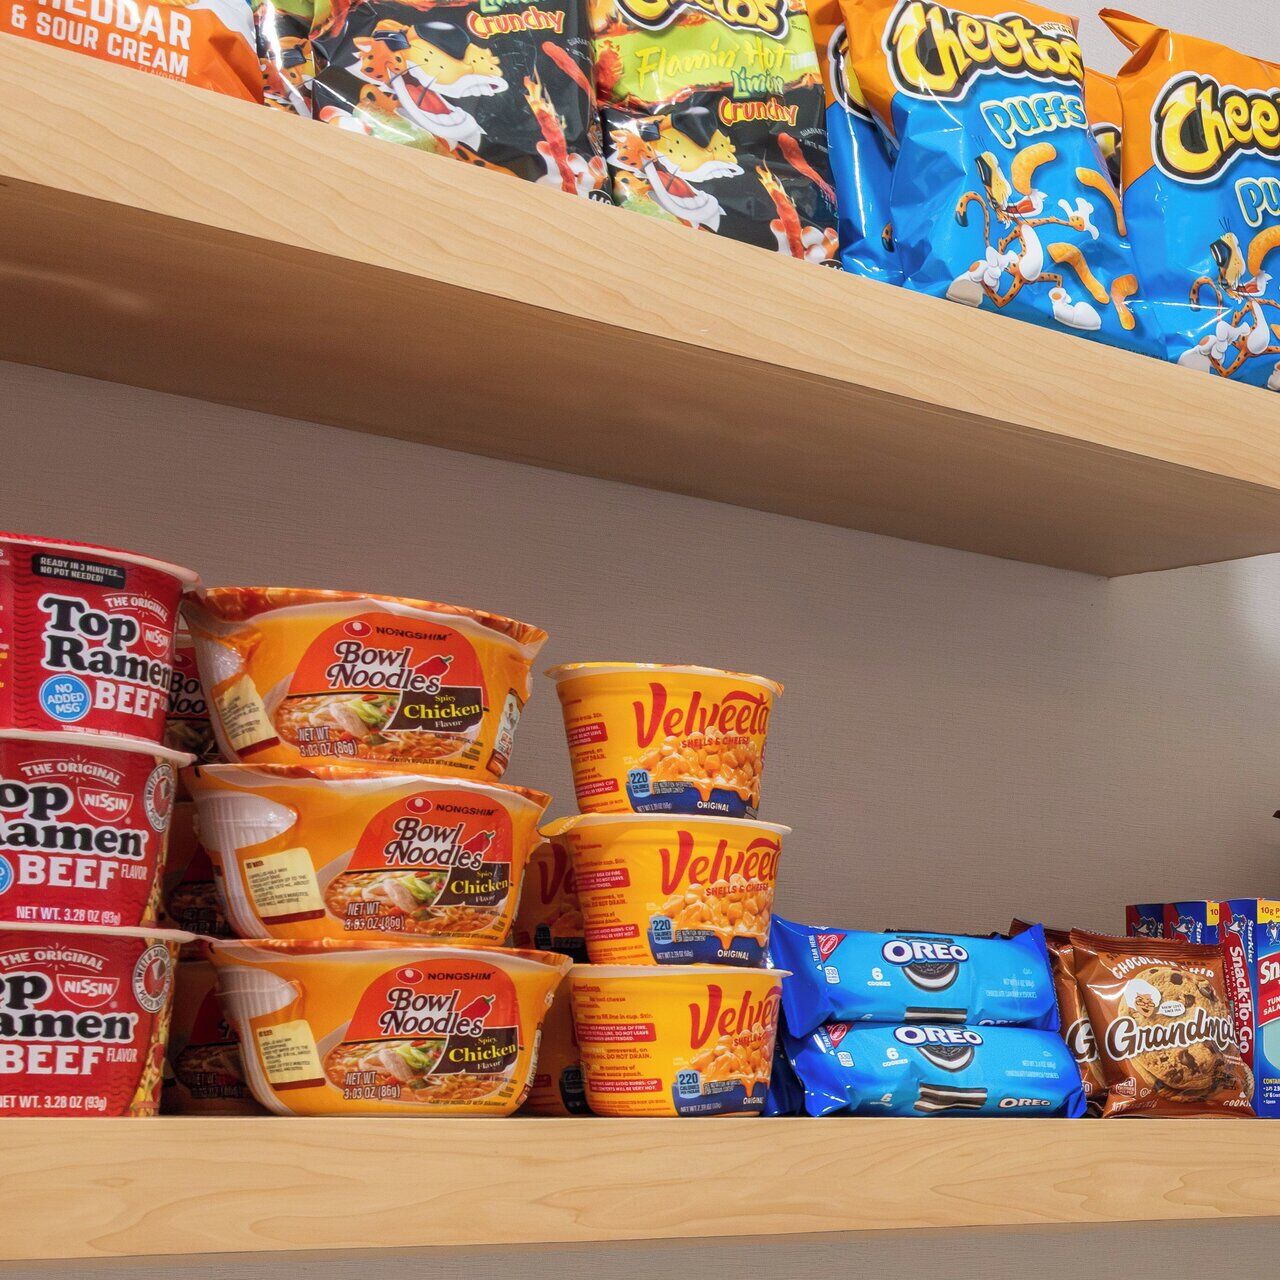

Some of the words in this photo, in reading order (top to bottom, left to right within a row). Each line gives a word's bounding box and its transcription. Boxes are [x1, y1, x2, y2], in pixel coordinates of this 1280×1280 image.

[467, 10, 565, 38] Crunchy
[11, 12, 26, 29] &
[36, 14, 99, 51] SOUR
[106, 33, 189, 78] CREAM
[718, 97, 799, 126] Crunchy
[105, 597, 129, 608] THE
[42, 597, 138, 650] Top
[376, 626, 451, 642] NONGSHIM
[46, 635, 171, 686] Ramen
[335, 642, 410, 668] Bowl
[327, 664, 441, 693] Noodles
[55, 684, 73, 695] NO
[48, 694, 85, 705] ADDED
[54, 703, 82, 714] MSG
[404, 703, 480, 720] Chicken
[20, 764, 53, 777] THE
[57, 761, 121, 785] ORIGINAL
[630, 771, 648, 783] 220
[84, 793, 128, 812] NISSIN
[436, 803, 497, 816] NONGSHIM
[697, 800, 729, 812] ORIGINAL
[394, 818, 463, 844] Bowl
[17, 855, 119, 890] BEEF
[121, 864, 147, 880] FLAVOR
[16, 906, 38, 919] NET
[64, 908, 85, 921] 3.28
[87, 909, 100, 922] OZ
[1261, 907, 1274, 915] 10g
[653, 919, 671, 931] 220
[33, 950, 103, 970] ORIGINAL
[718, 949, 749, 960] ORIGINAL
[884, 941, 968, 963] OREO
[872, 968, 883, 979] 6
[64, 979, 113, 997] NISSIN
[380, 1011, 483, 1036] Noodles
[449, 1043, 516, 1062] Chicken
[44, 1096, 67, 1109] 3.28
[999, 1097, 1050, 1108] OREO
